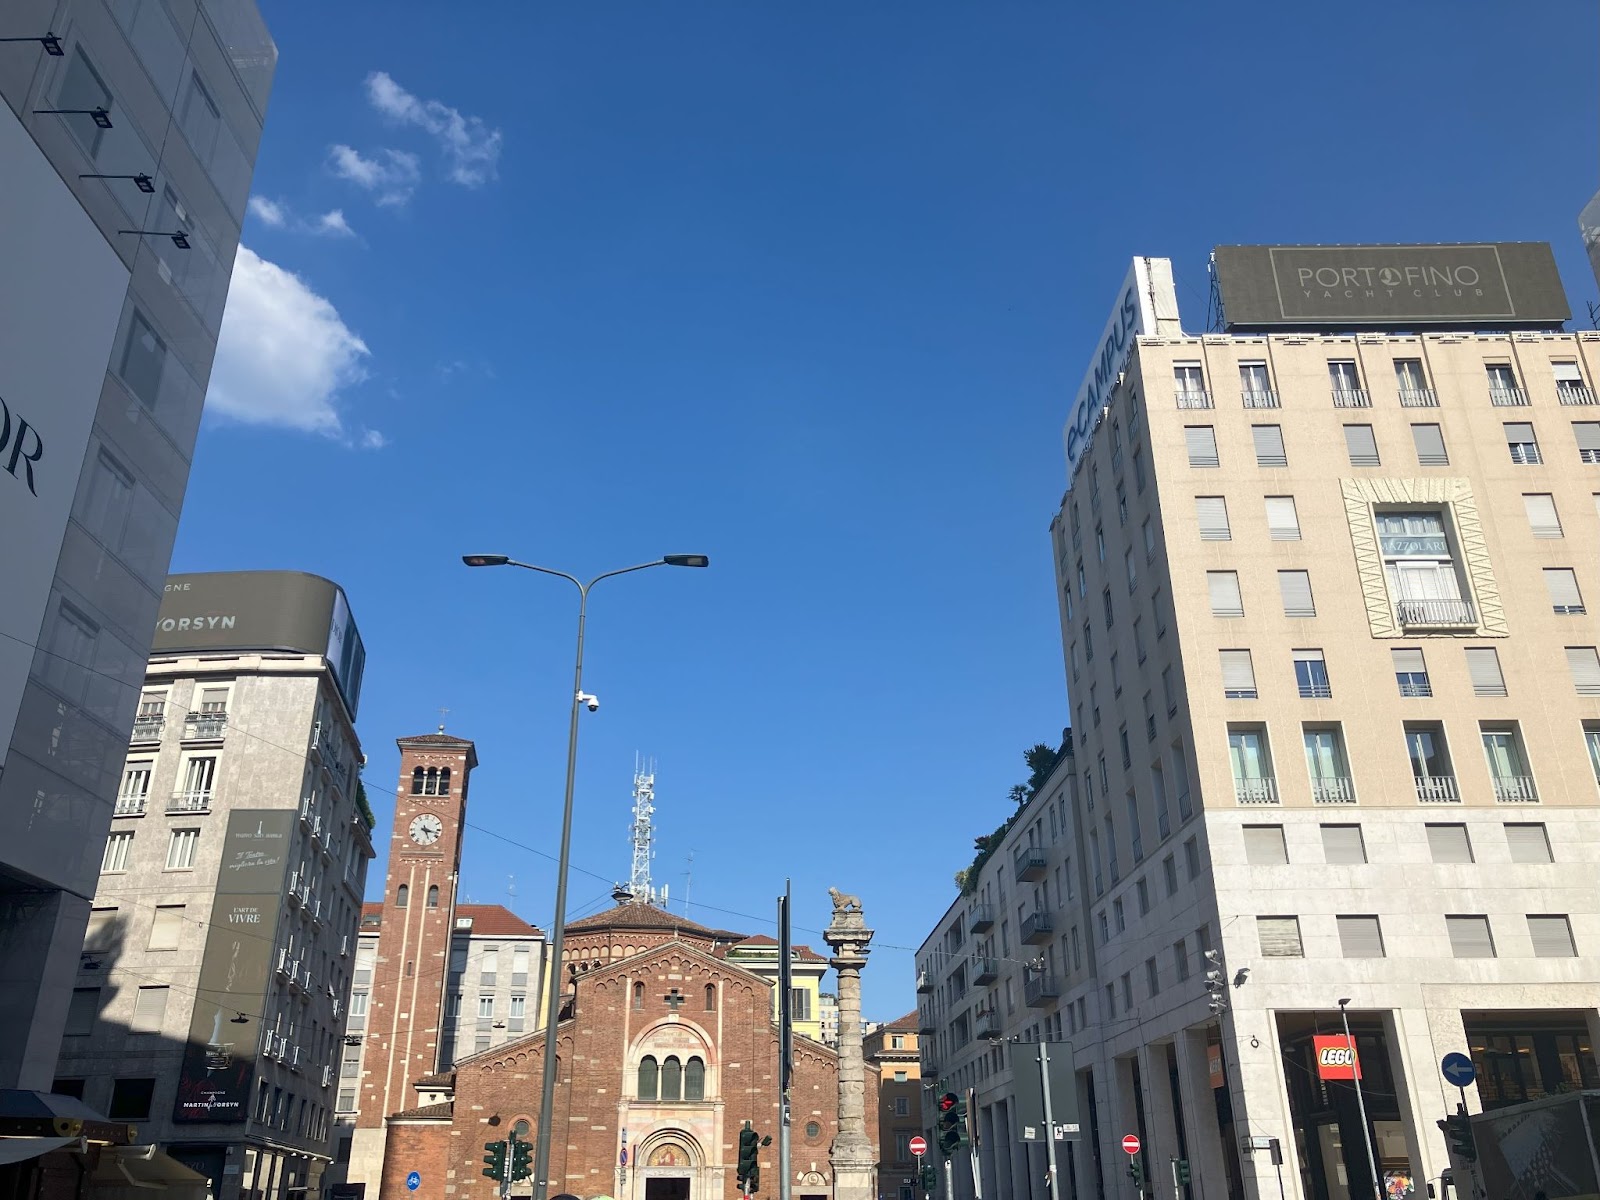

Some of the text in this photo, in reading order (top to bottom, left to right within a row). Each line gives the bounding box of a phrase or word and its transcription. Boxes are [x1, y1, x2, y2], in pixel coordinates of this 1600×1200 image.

[1297, 265, 1480, 288] PORTOFINO
[1303, 288, 1484, 299] YACHT CLUB
[228, 913, 261, 924] VIVRE
[1320, 1048, 1356, 1066] LEGO
